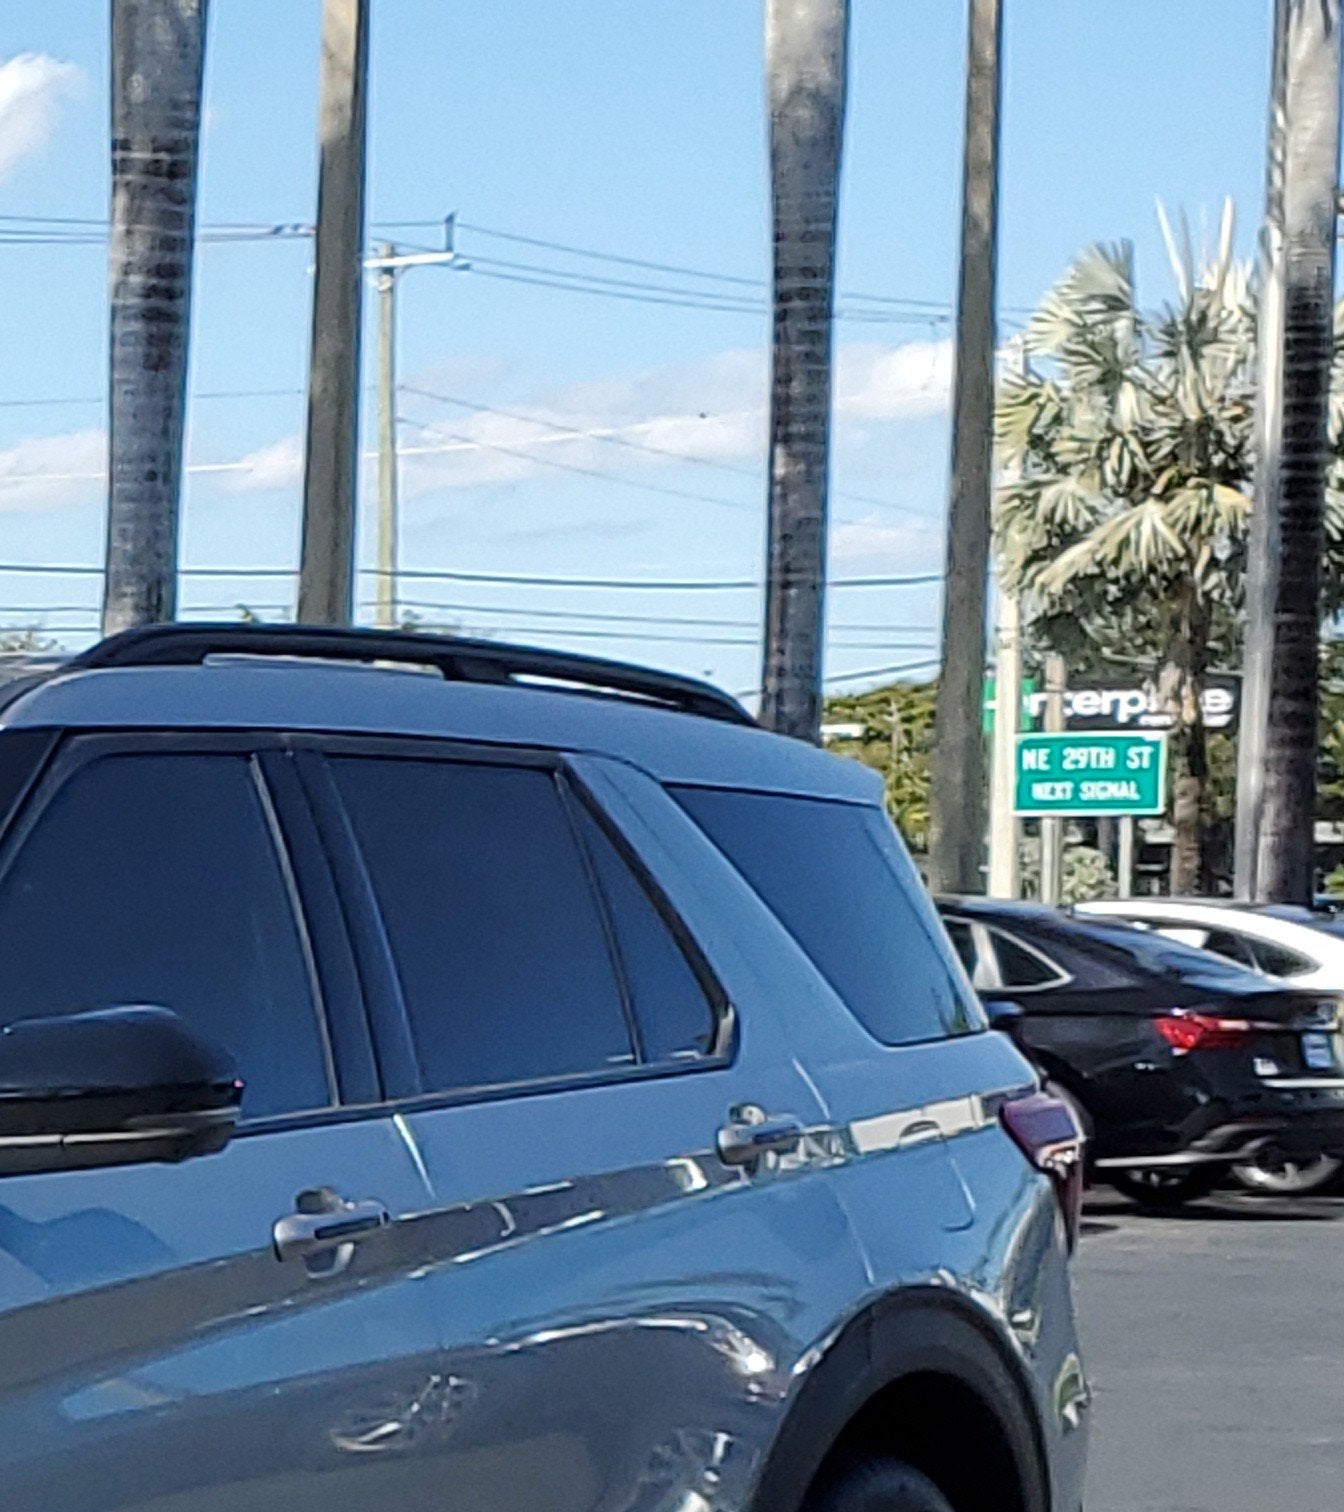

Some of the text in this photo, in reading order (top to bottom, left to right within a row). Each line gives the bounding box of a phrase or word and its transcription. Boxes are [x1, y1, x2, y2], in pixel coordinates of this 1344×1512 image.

[1022, 745, 1154, 771] NE 29TH ST
[1031, 780, 1141, 801] NEXT SIGNAL
